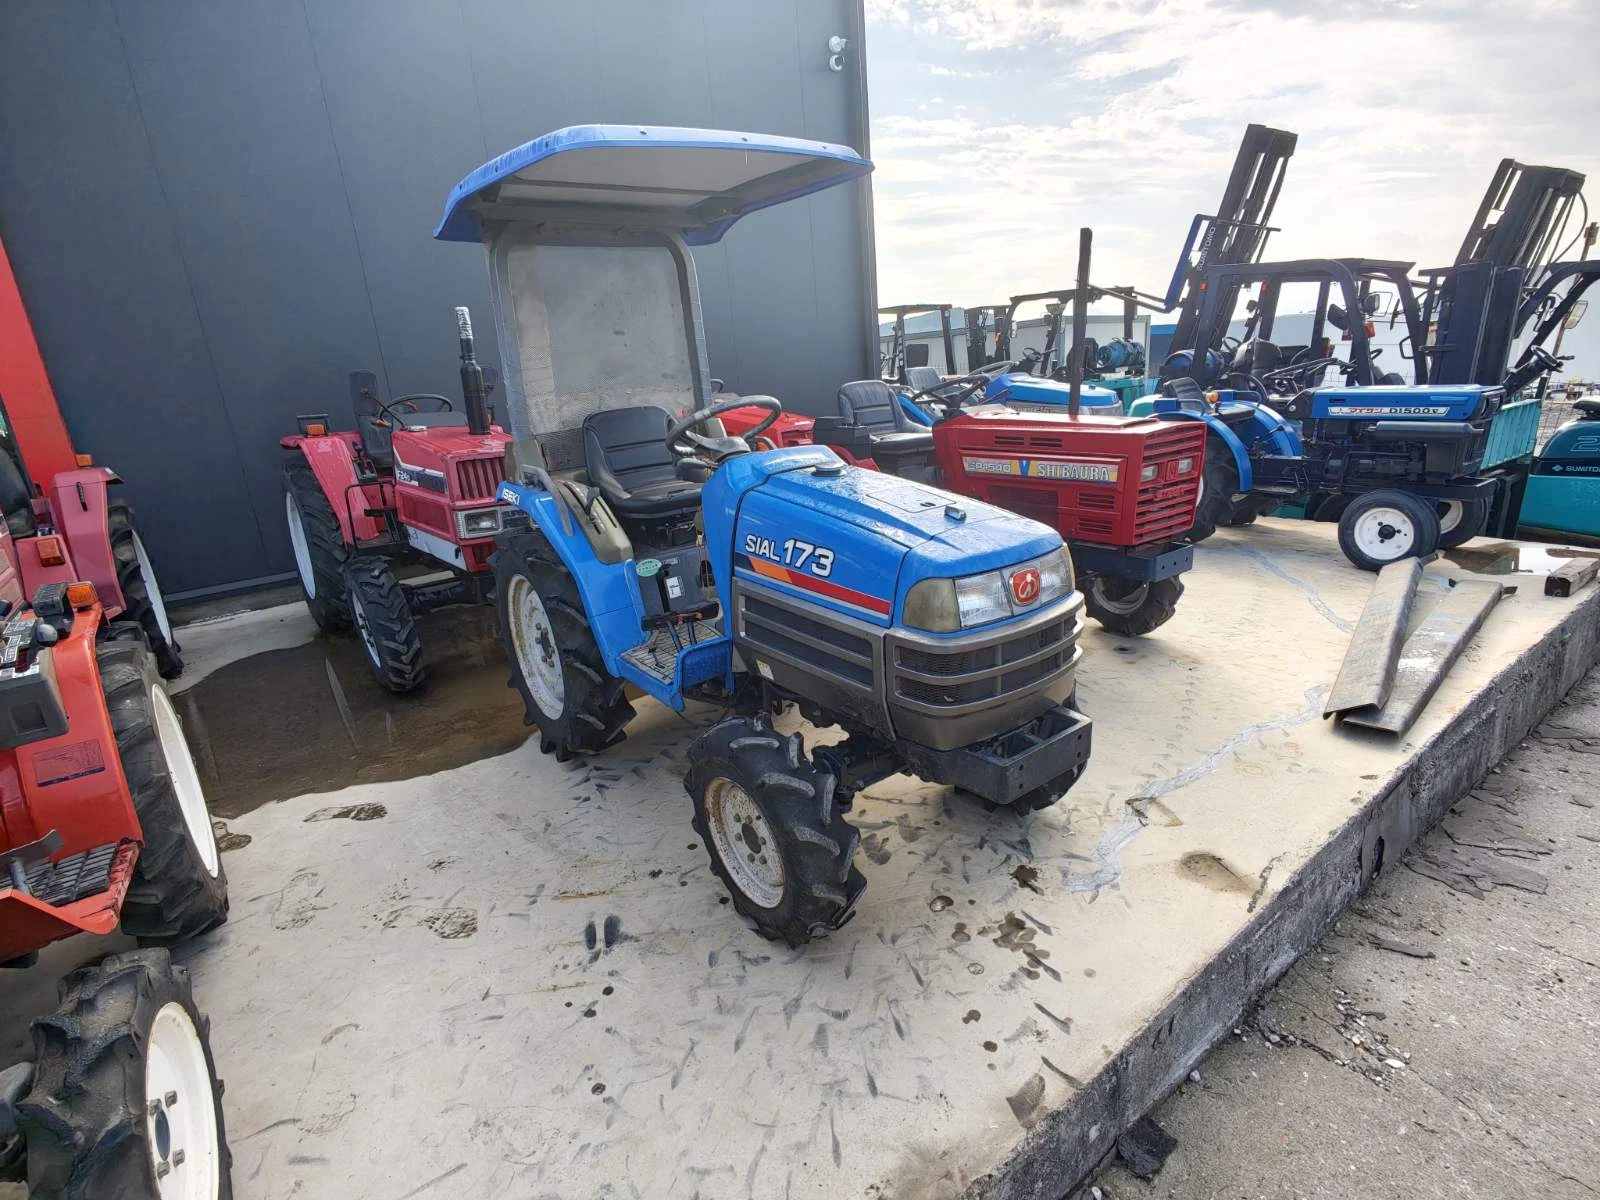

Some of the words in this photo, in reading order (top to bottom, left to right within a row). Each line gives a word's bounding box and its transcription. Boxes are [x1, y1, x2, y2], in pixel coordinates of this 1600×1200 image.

[1037, 463, 1110, 481] SHIBAURA
[1565, 465, 1600, 473] SUMITO
[502, 487, 520, 505] ISEKI
[745, 534, 781, 562] SIAL
[783, 538, 835, 577] 173
